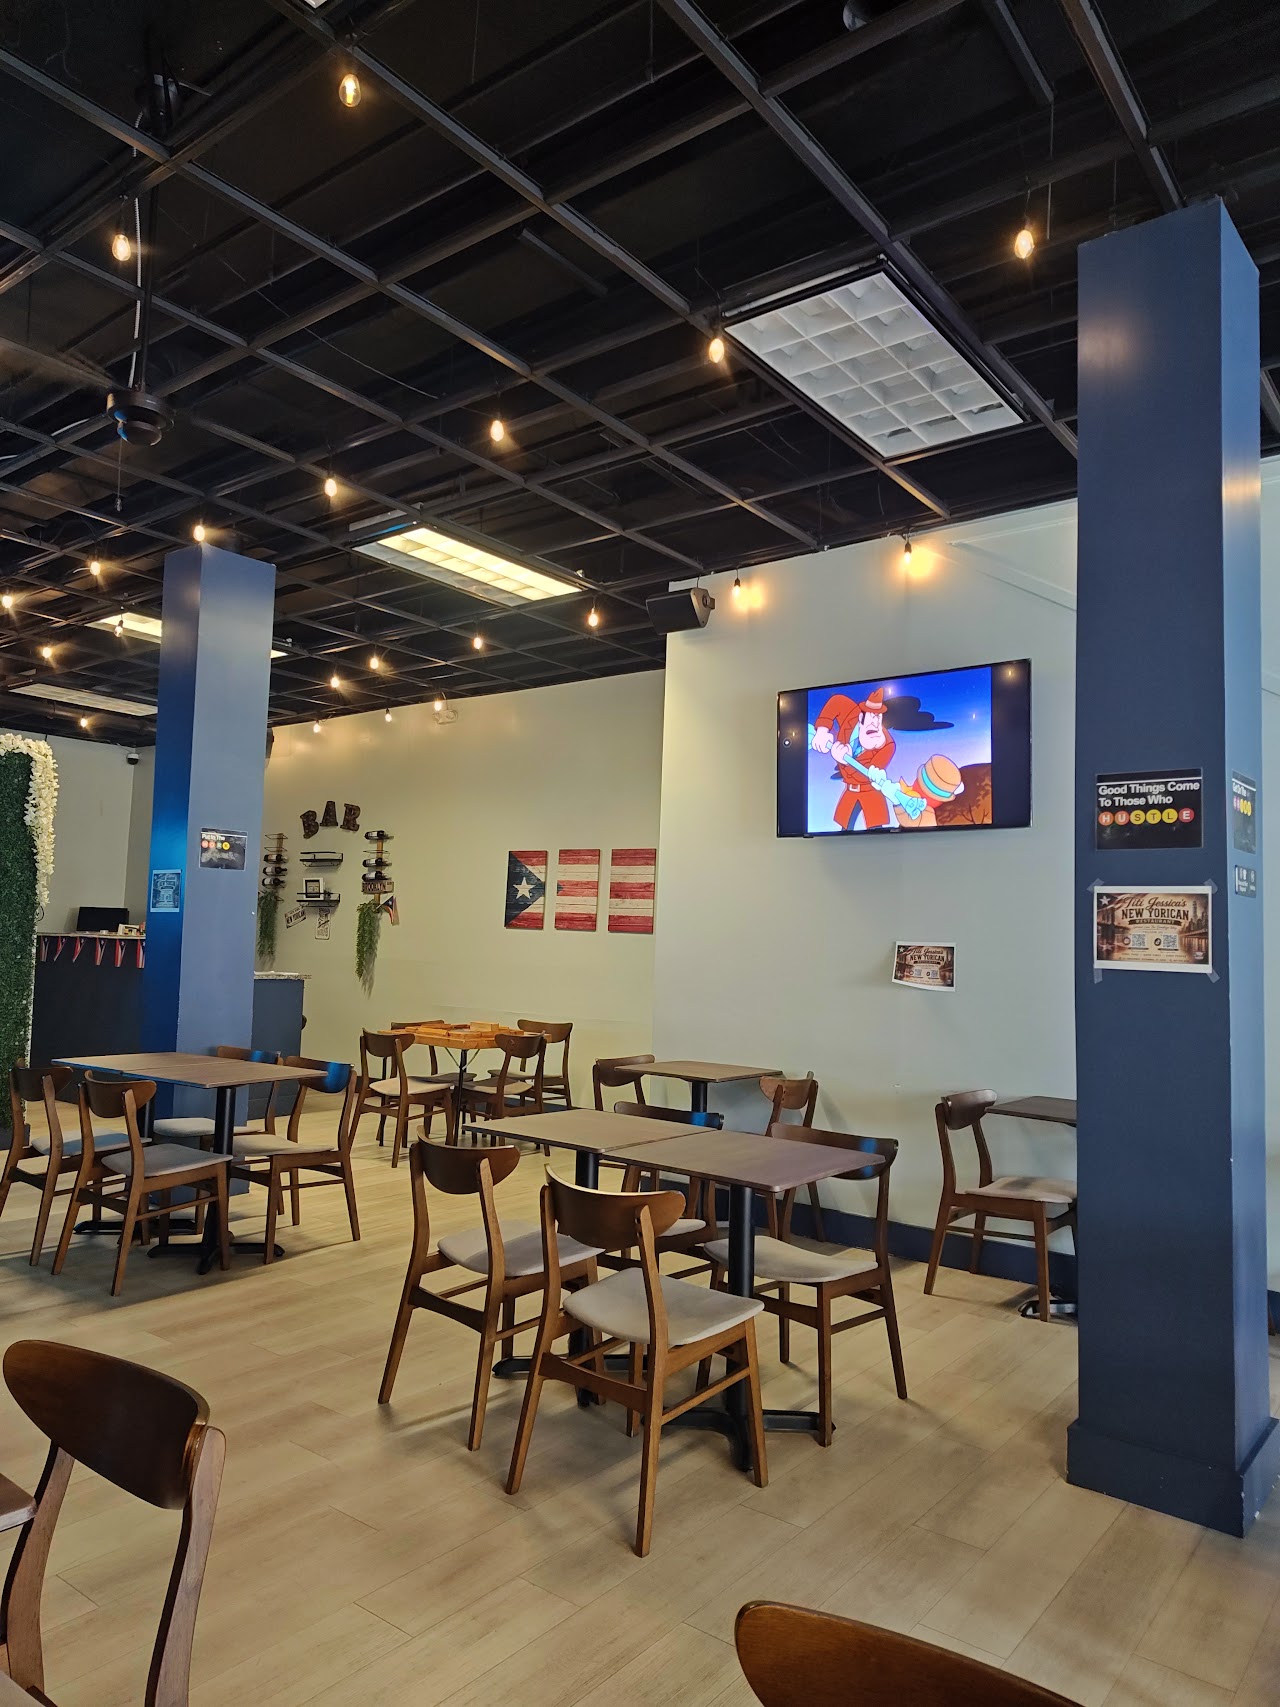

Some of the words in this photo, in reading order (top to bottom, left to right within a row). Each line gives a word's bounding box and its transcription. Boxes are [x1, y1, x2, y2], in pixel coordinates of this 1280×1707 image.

[1098, 785, 1127, 795] Good
[1129, 782, 1165, 794] Things
[1167, 781, 1200, 791] Come
[1098, 797, 1112, 807] To
[1113, 797, 1146, 806] Those
[1147, 795, 1173, 804] Who
[300, 800, 361, 839] BAR
[1099, 809, 1193, 824] HUSTLE
[1145, 897, 1187, 910] Jessica's
[1122, 908, 1144, 919] NEW
[1148, 908, 1189, 920] YORICAN
